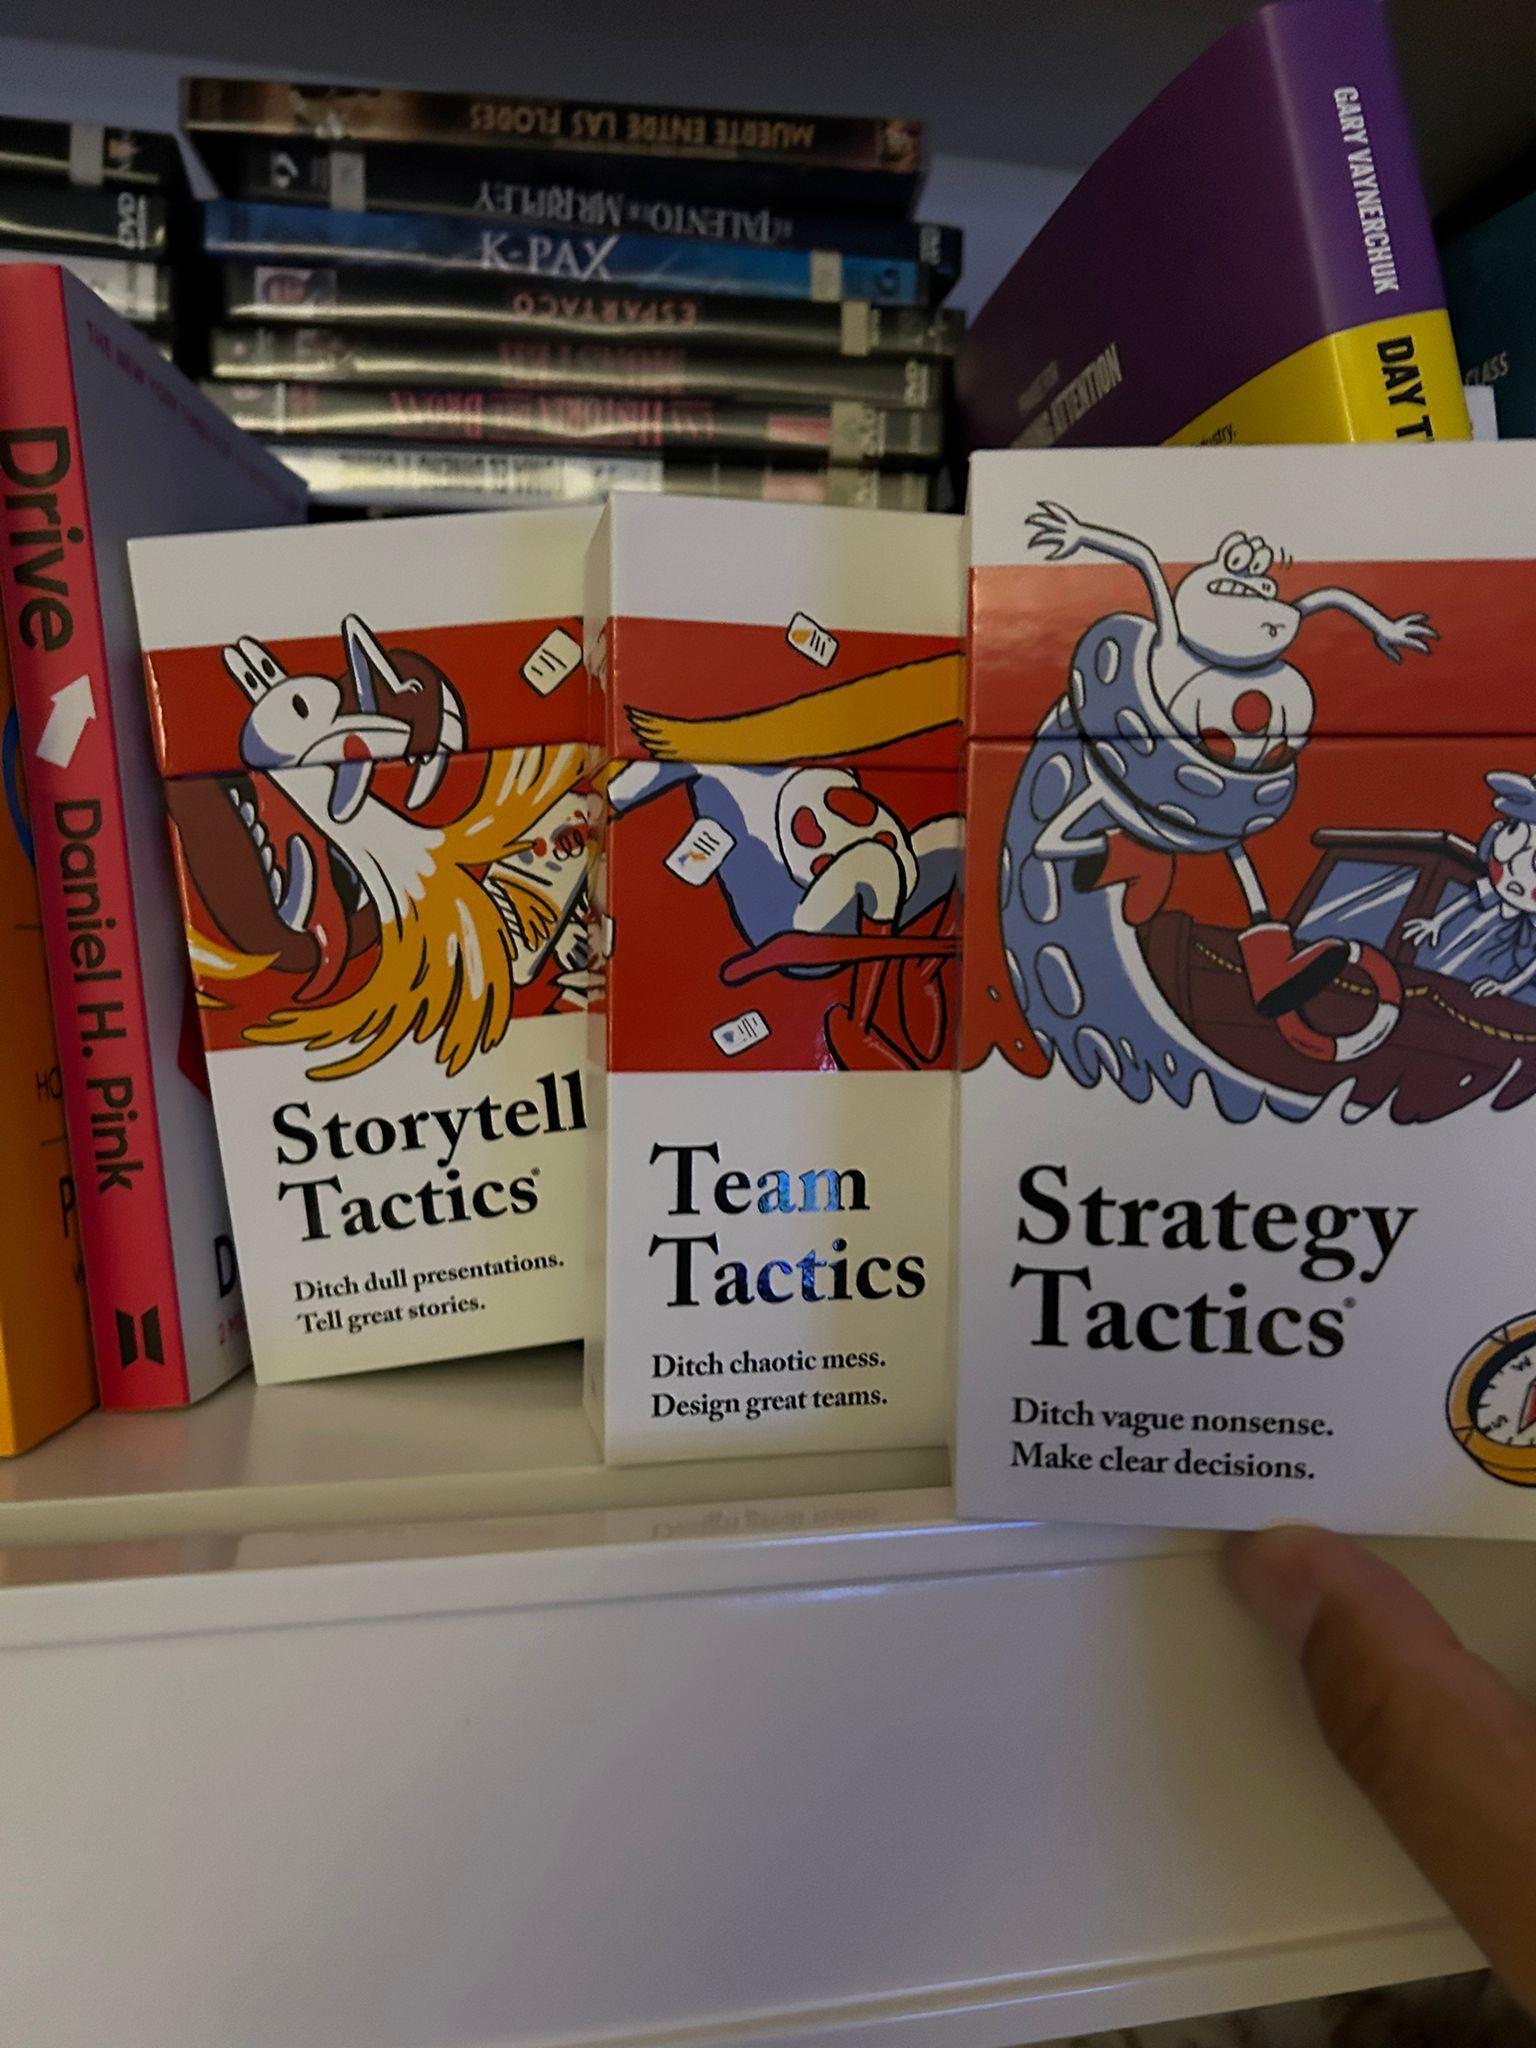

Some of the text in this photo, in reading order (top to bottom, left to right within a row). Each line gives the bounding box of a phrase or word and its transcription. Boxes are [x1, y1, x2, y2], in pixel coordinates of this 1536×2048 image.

[469, 102, 816, 149] MUERTE ENTRE LAS FLORES
[1333, 86, 1399, 295] GARY VAYNERCHUK
[479, 229, 621, 282] K-PAX
[511, 292, 698, 328] ESPARTACO
[1376, 335, 1427, 407] DAY
[1, 426, 85, 653] Drive
[53, 798, 144, 1195] Daniel H. Pink
[272, 1069, 588, 1168] Storytell
[648, 1141, 870, 1216] Team
[1016, 1163, 1419, 1284] Strategy
[293, 1253, 565, 1302] Ditch dull presentations.
[648, 1232, 926, 1308] Tactics
[296, 1294, 486, 1334] Tell great stories.
[651, 1348, 887, 1379] Ditch chaotic mess.
[651, 1386, 889, 1422] Design great teams.
[1010, 1397, 1335, 1438] Ditch vague nonsense.
[1010, 1440, 1316, 1480] Make clear decisions.
